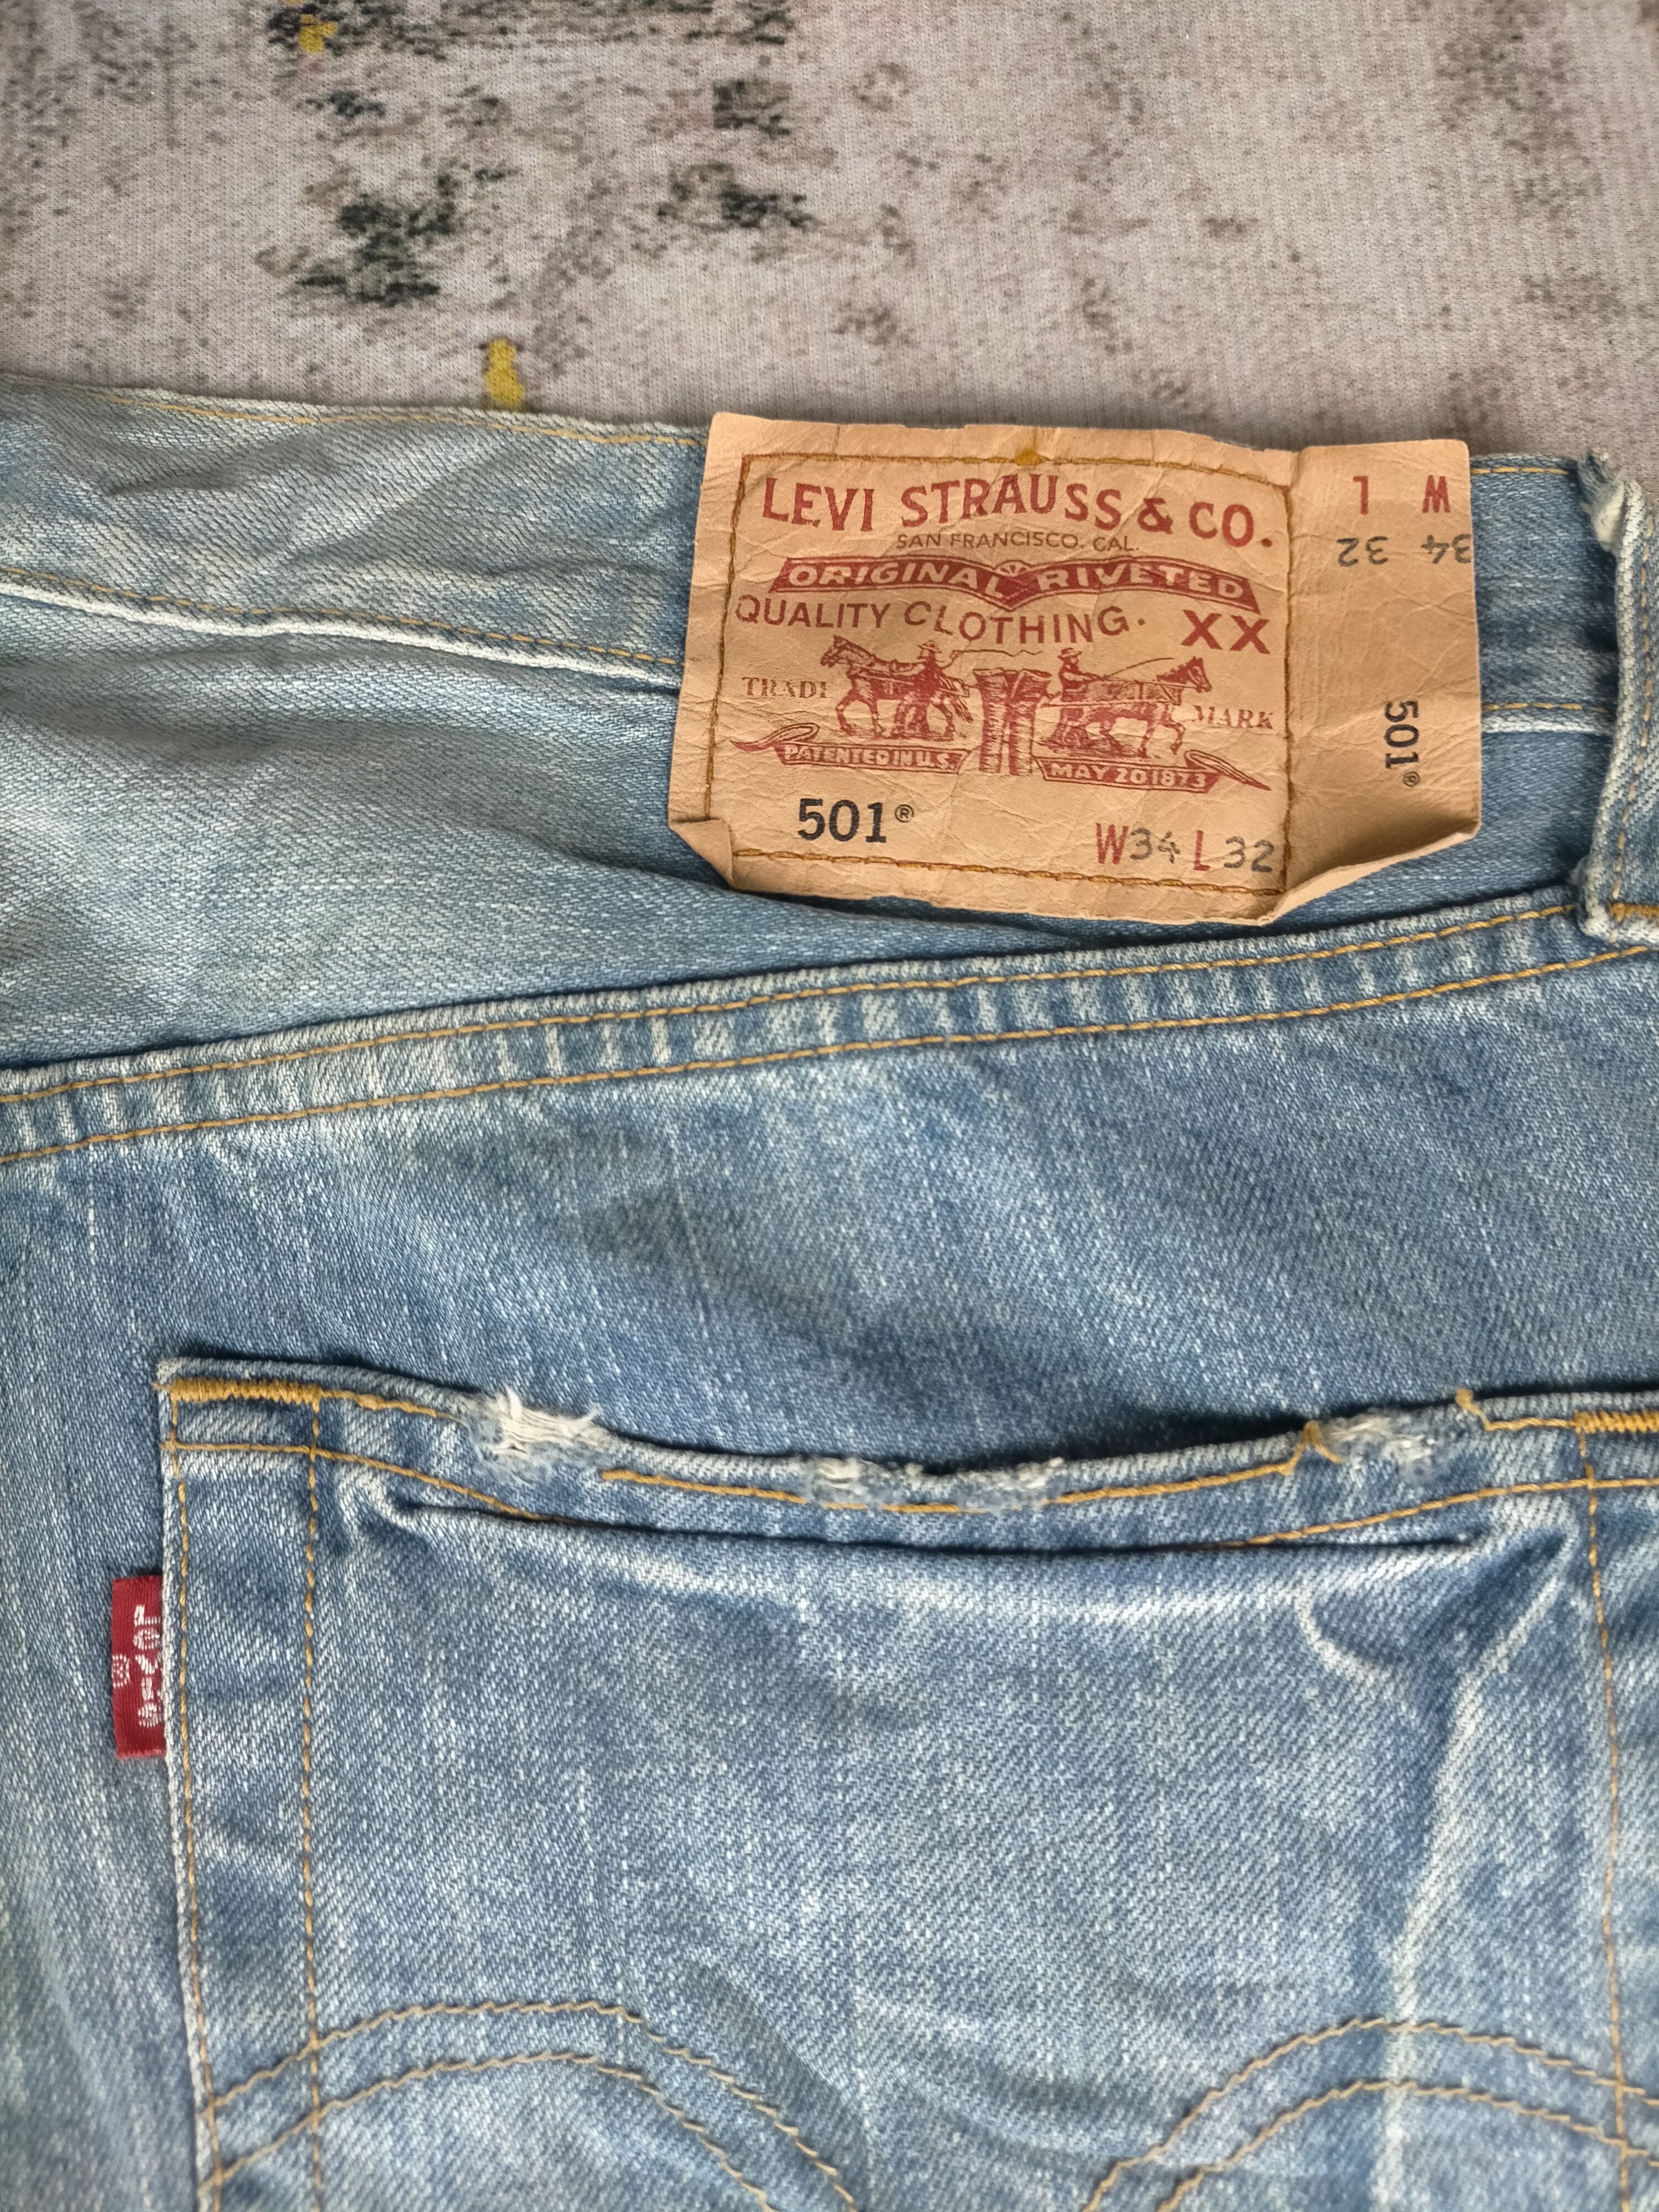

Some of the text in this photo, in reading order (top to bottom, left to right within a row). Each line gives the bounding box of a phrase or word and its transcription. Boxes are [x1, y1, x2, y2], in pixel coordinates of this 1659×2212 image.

[762, 473, 1272, 547] LEVI STRAUSS & CO.
[1353, 475, 1451, 515] W L
[895, 533, 941, 550] SAN
[1093, 536, 1139, 552] CAL.
[1335, 534, 1472, 567] 34 32
[788, 561, 1244, 599] ORIGINAL RIVETED
[735, 595, 891, 629] QUALITY
[1181, 609, 1271, 655] XX
[1194, 705, 1273, 729] MARK
[784, 744, 889, 765] PATENTED
[1051, 763, 1111, 779] MAY
